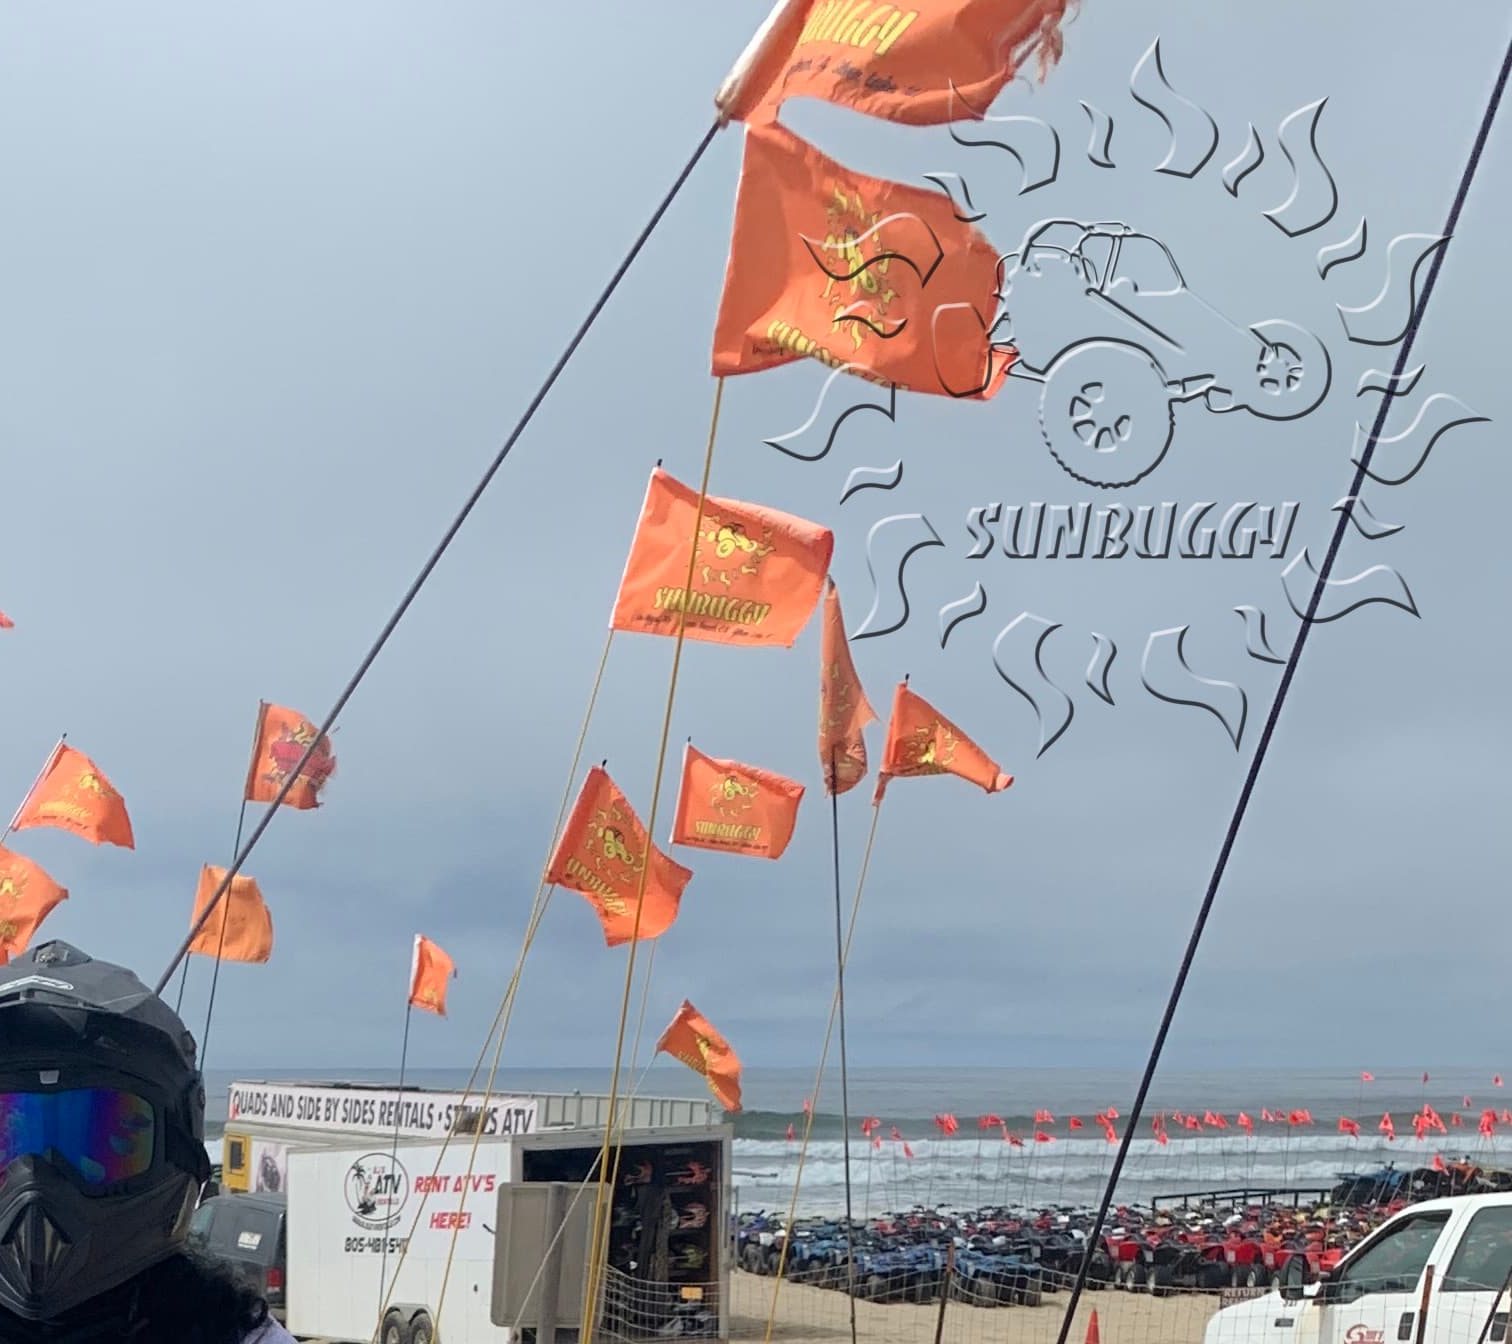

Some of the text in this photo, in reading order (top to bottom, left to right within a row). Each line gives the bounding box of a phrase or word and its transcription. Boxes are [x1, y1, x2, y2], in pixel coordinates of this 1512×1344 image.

[233, 1090, 268, 1115] QUADS
[271, 1093, 294, 1118] AND
[296, 1095, 321, 1121] SIDE
[324, 1096, 340, 1122] BY
[342, 1098, 375, 1125] SIDES
[379, 1101, 434, 1130] RENTALS
[501, 1108, 534, 1134] ATV
[374, 1174, 402, 1195] ATV
[414, 1175, 450, 1193] RENT
[429, 1212, 472, 1229] HERE!
